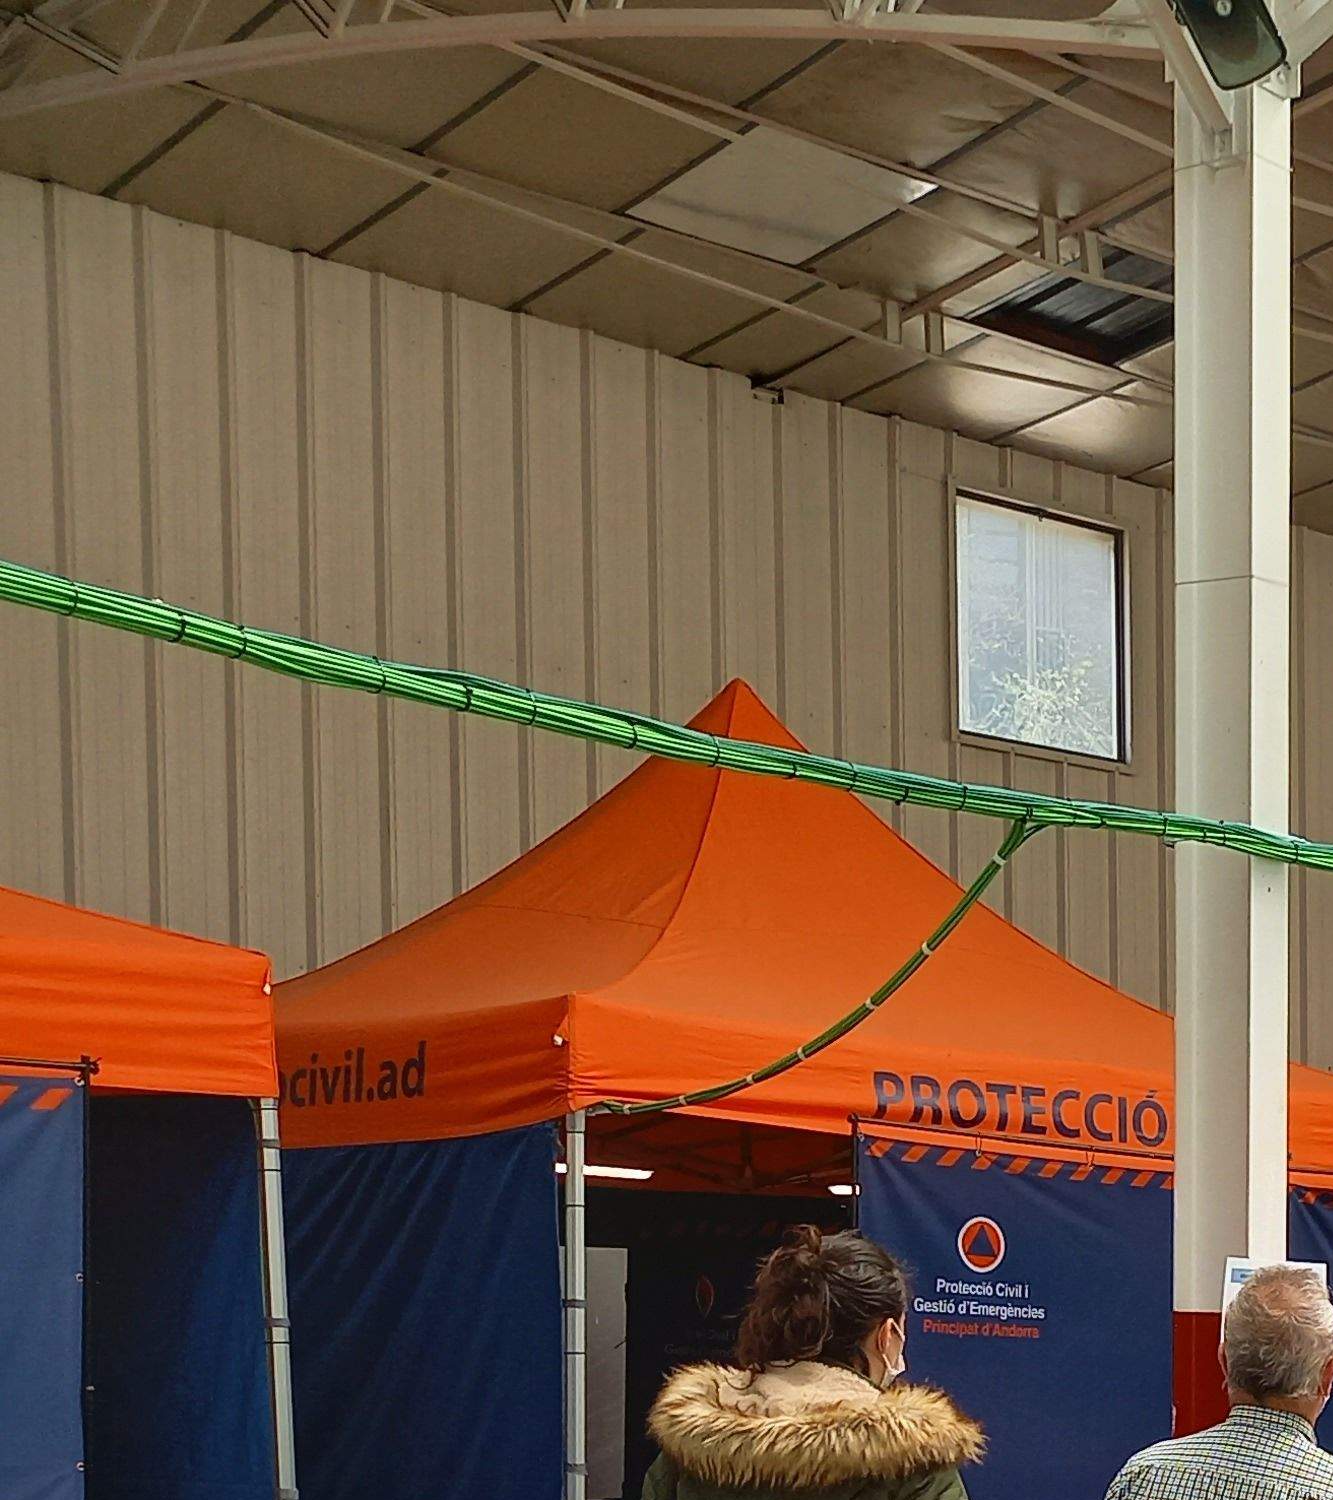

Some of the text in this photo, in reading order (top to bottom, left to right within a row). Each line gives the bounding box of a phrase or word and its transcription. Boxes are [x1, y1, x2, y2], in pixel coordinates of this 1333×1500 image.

[872, 1071, 1168, 1147] PROTECCIÓ
[936, 1278, 993, 1297] Protecció
[995, 1283, 1022, 1298] Civil
[914, 1297, 1045, 1320] Gestió d'Emergències
[923, 1319, 1040, 1338] Principat d'Andorra
